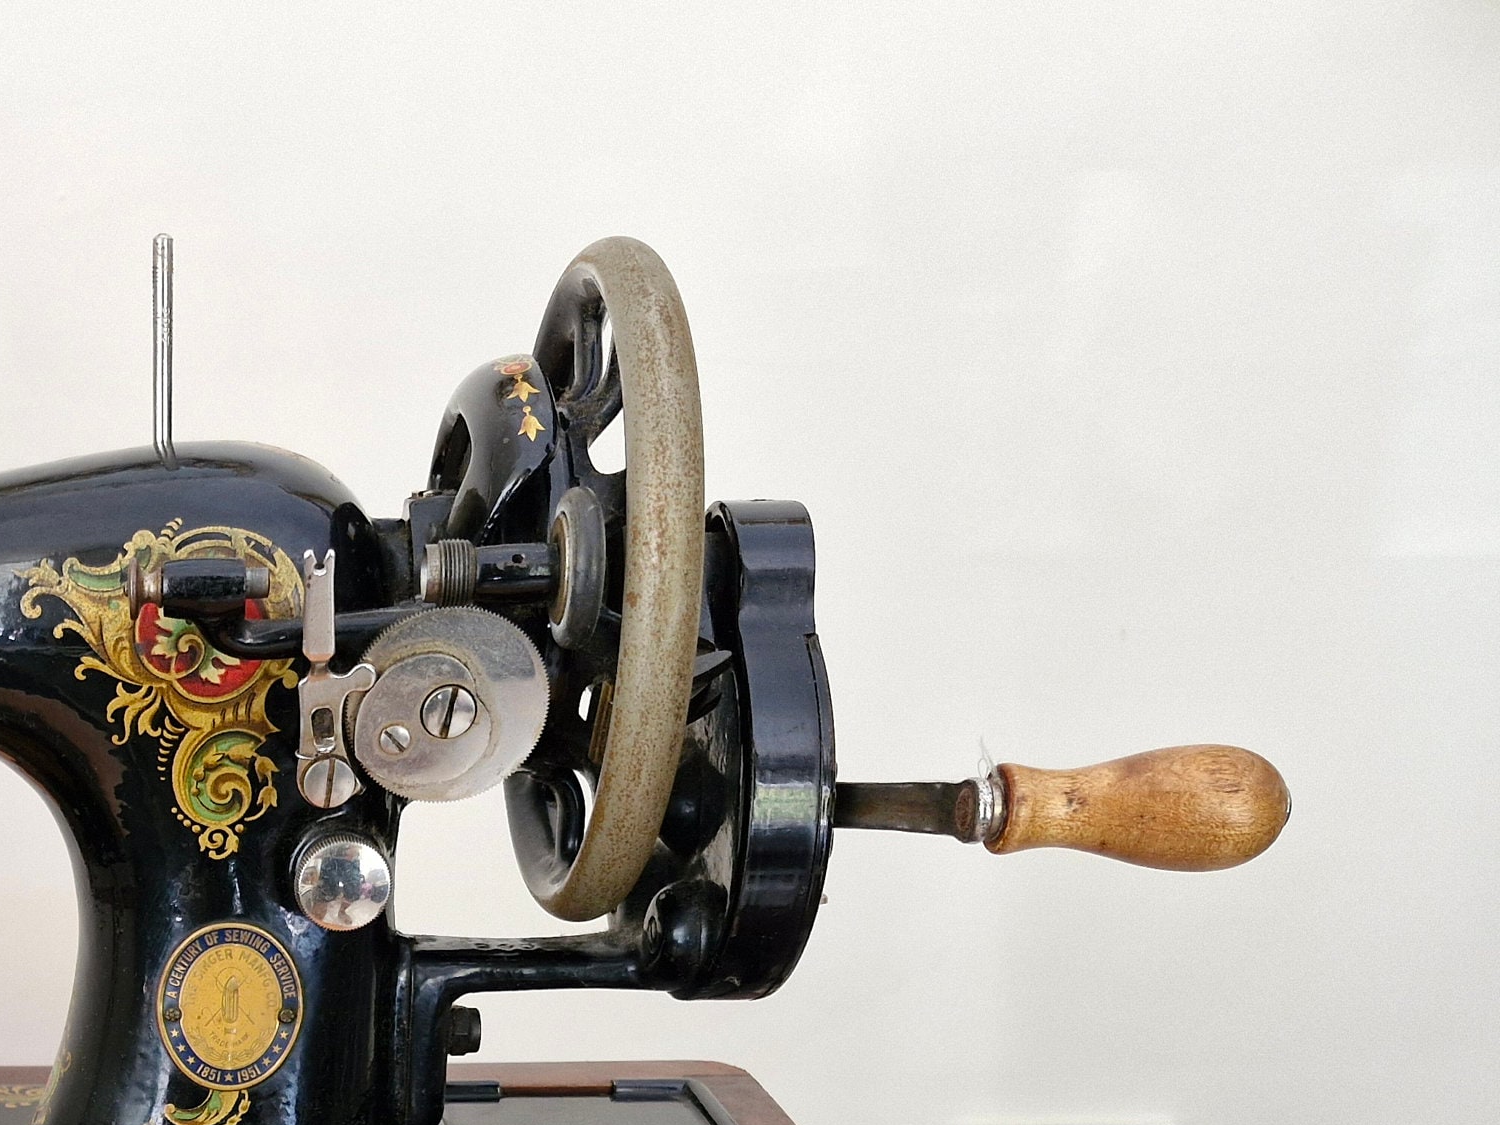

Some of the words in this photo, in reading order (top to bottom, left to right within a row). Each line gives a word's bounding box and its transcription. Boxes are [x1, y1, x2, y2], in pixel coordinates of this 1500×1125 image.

[204, 931, 220, 947] OF
[224, 929, 272, 954] SEWING
[170, 940, 203, 987] CENTURY
[193, 948, 234, 981] SINGER
[269, 952, 297, 1000] SERVICE
[166, 991, 178, 999] A
[196, 1063, 221, 1083] 1851
[237, 1064, 262, 1083] 1951
